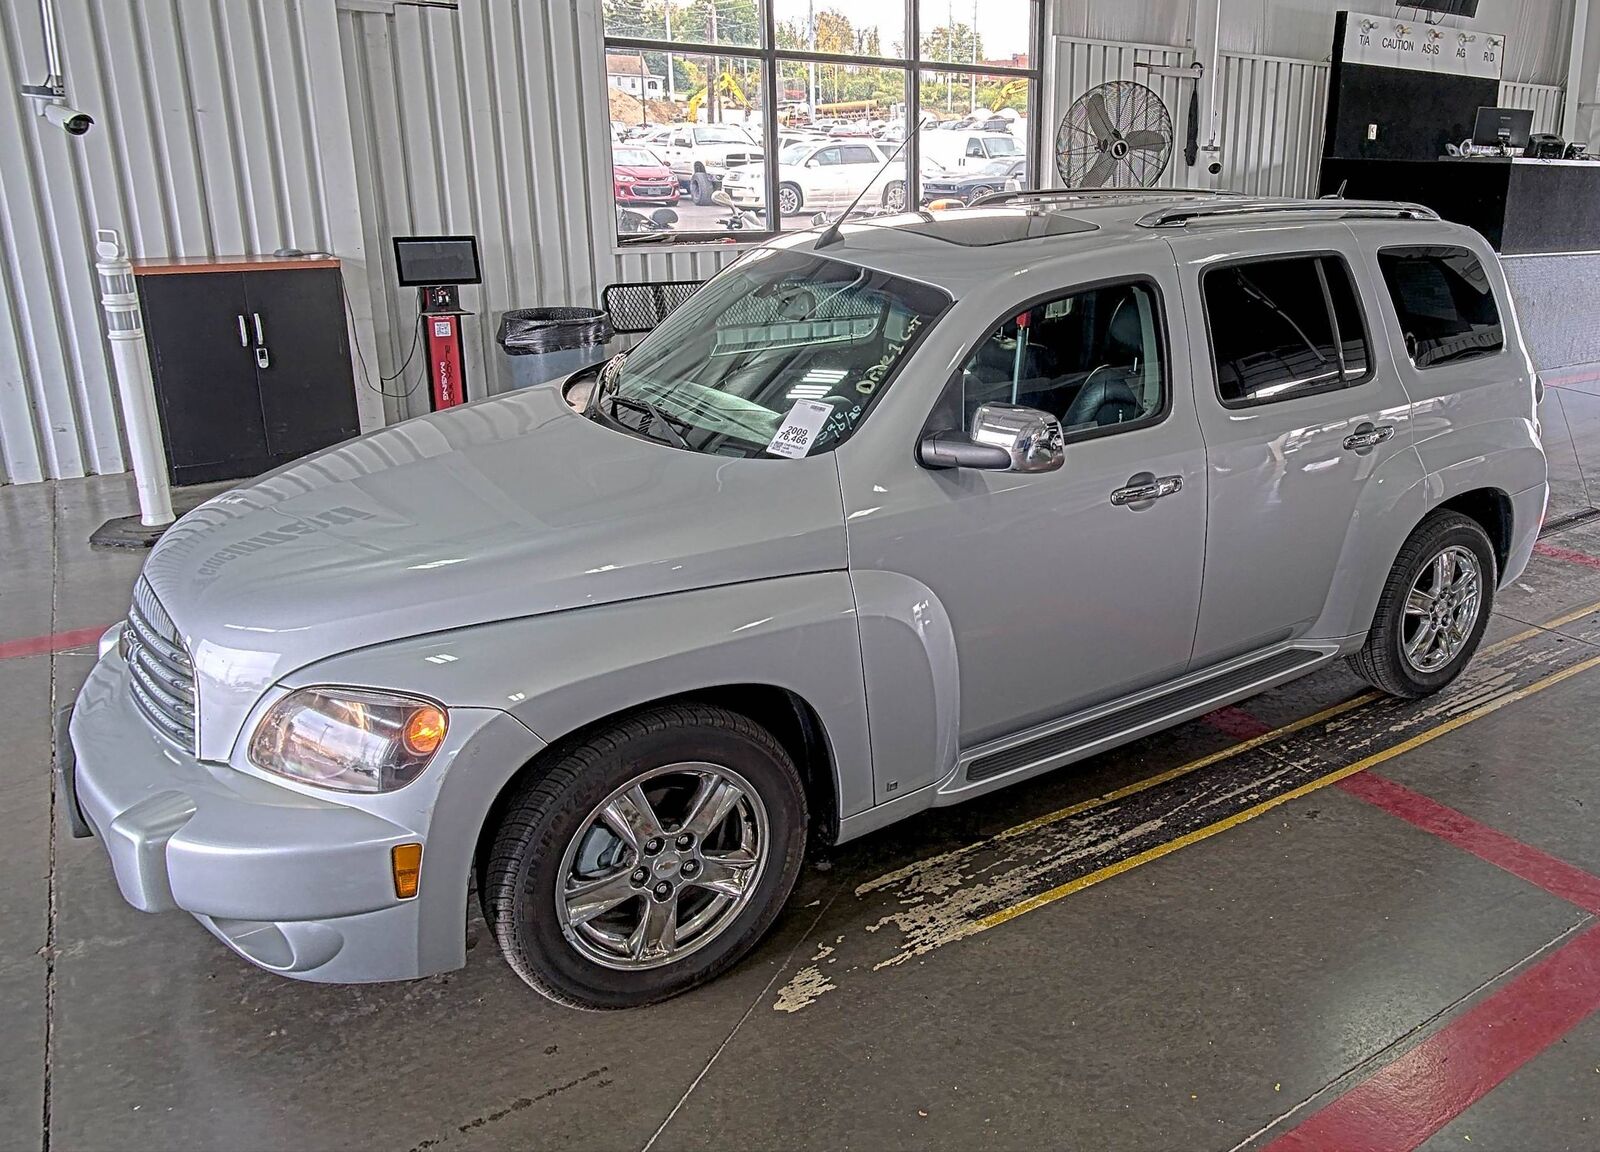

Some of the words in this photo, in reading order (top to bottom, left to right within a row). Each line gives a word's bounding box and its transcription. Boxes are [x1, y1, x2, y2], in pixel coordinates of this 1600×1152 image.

[1359, 34, 1370, 46] T/A
[1382, 37, 1414, 52] CAUTION
[1421, 43, 1440, 55] AS-IS
[1456, 48, 1466, 58] AG
[778, 431, 808, 446] 76,466
[786, 425, 808, 437] 2009
